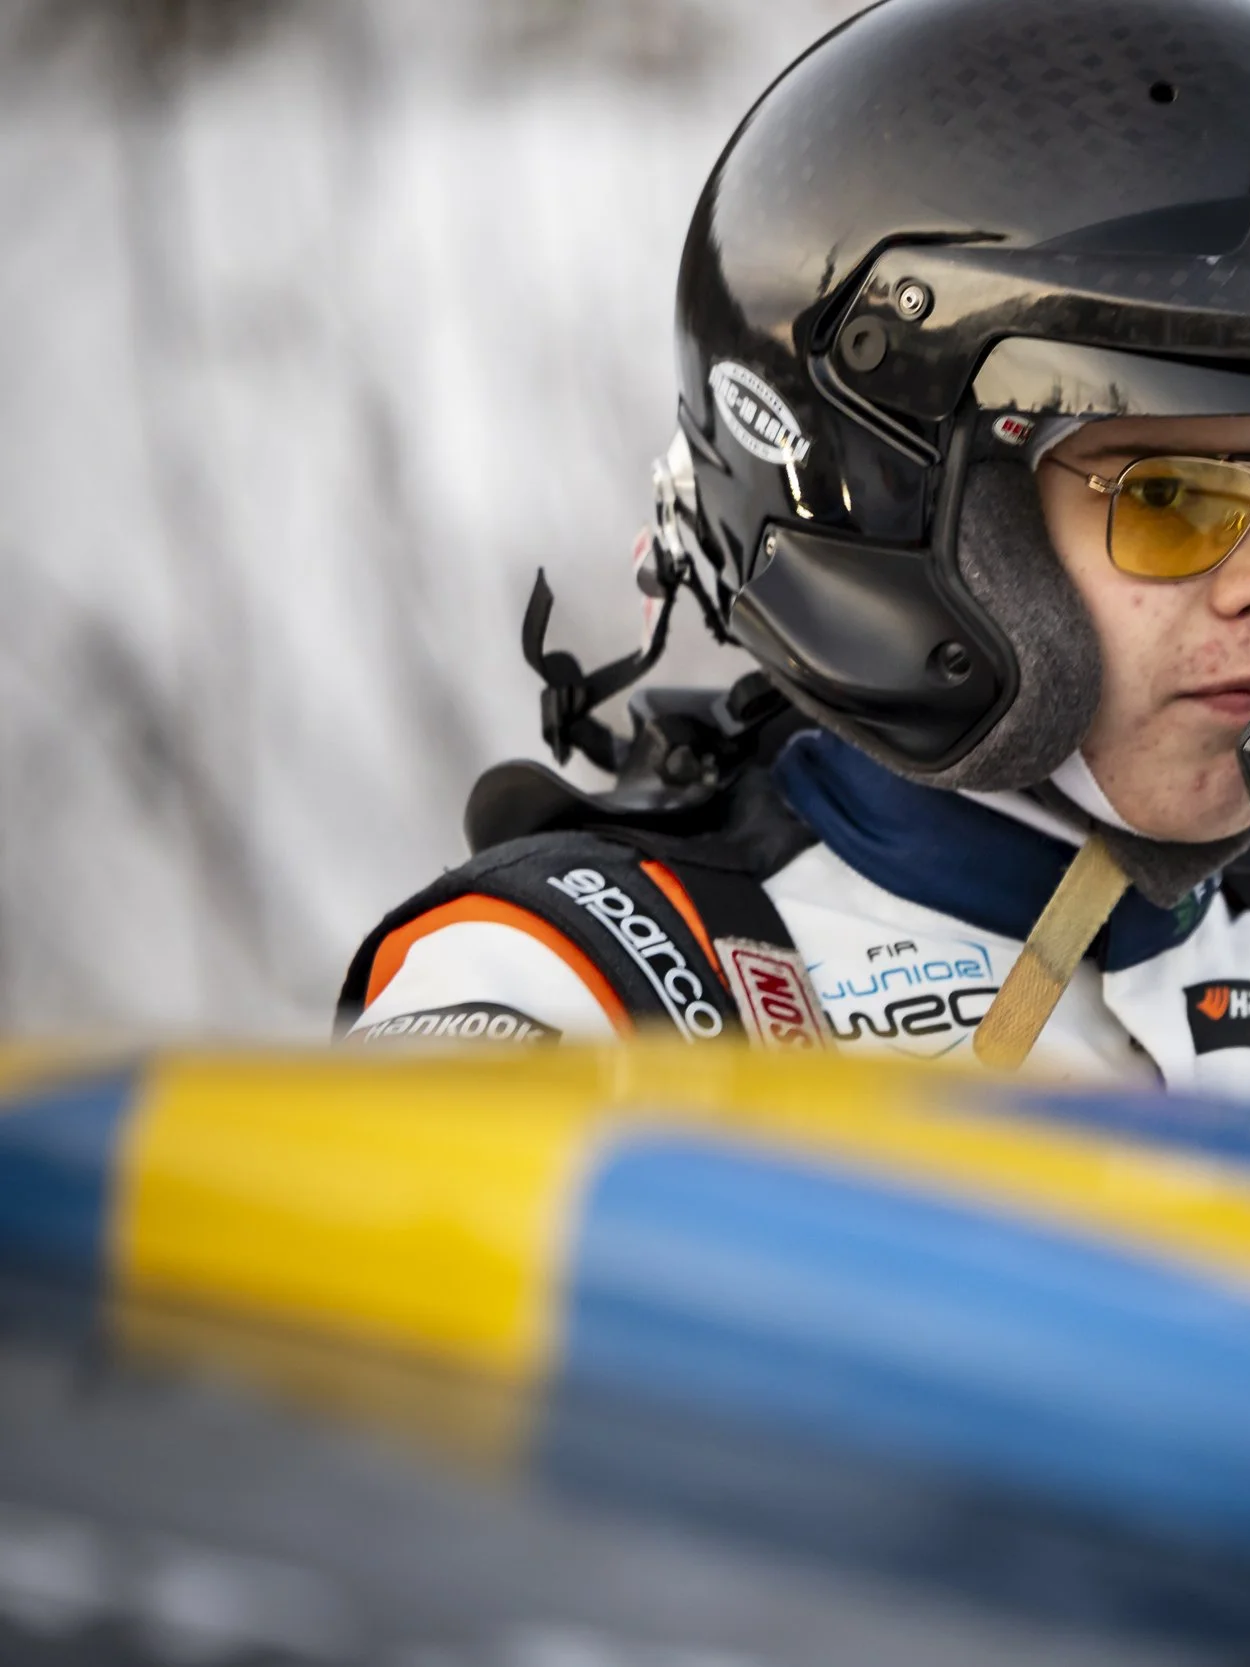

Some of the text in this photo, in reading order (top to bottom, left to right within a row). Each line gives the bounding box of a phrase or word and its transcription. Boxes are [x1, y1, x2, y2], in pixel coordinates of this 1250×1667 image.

[563, 868, 723, 1038] sparco
[866, 940, 918, 962] FIA
[823, 987, 1003, 1040] WRC
